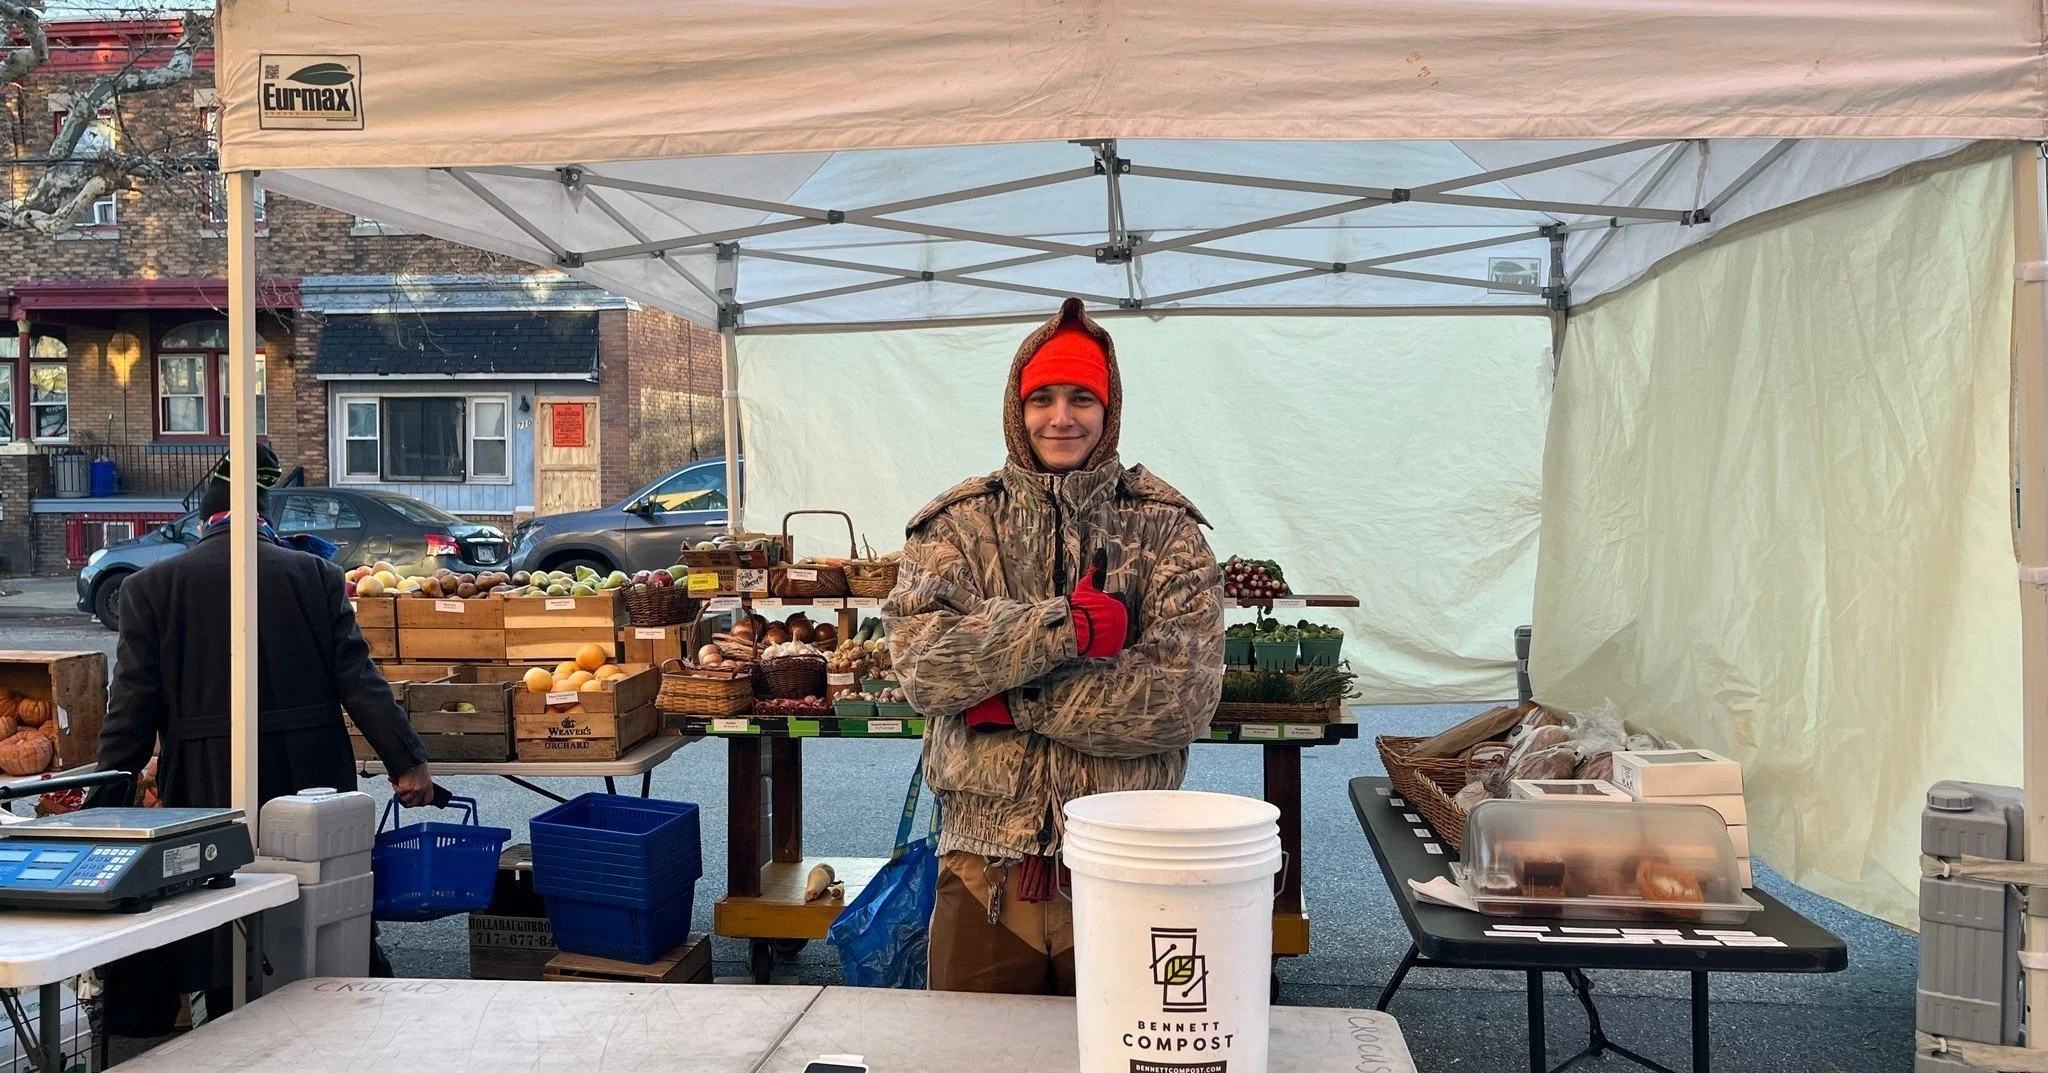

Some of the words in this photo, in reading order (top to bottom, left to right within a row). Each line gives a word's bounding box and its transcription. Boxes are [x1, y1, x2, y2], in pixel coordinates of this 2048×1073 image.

[263, 83, 352, 112] Eurmax
[313, 981, 456, 995] CROCUS
[1138, 1020, 1219, 1032] BENNETT
[1122, 1033, 1234, 1052] COMPOST
[1347, 1016, 1392, 1073] CROCUS
[1135, 1064, 1222, 1073] BENNETTCOMPOST.COM
